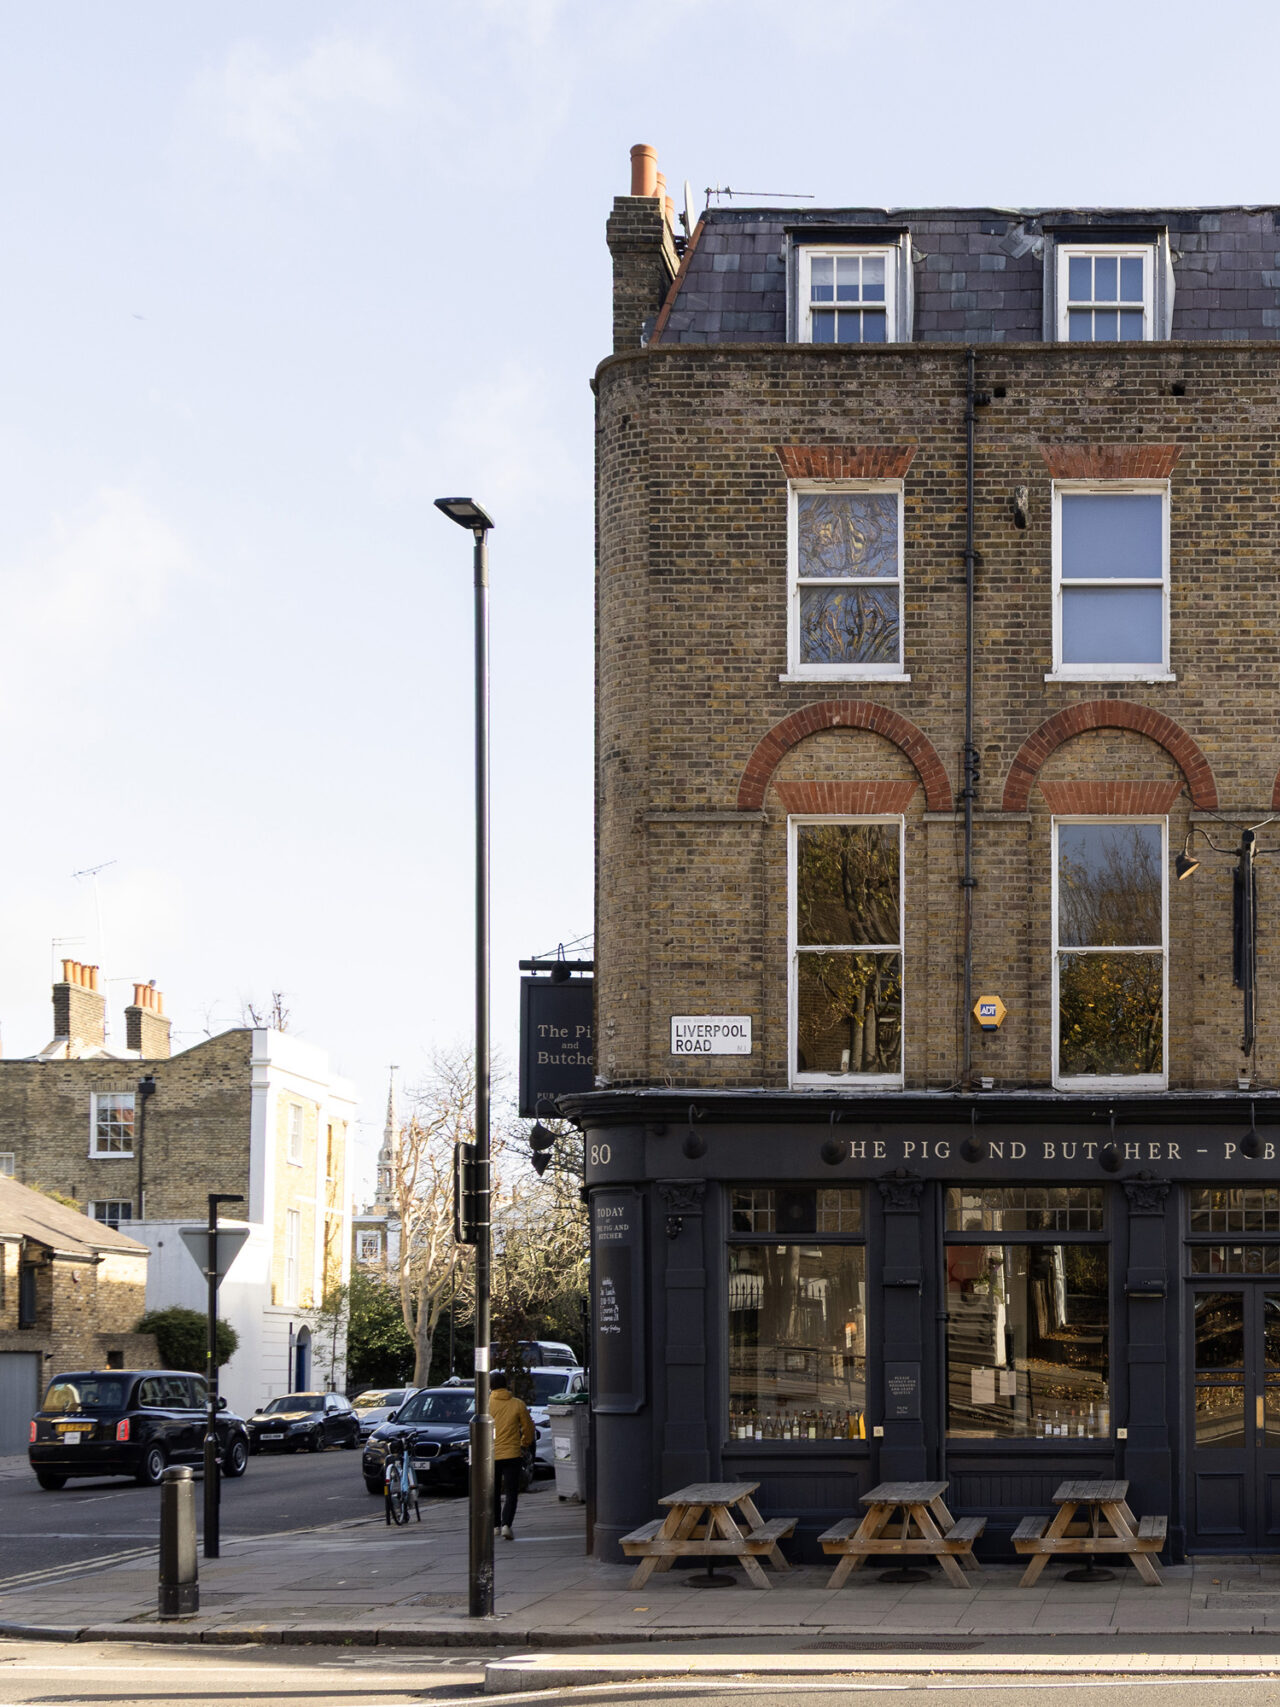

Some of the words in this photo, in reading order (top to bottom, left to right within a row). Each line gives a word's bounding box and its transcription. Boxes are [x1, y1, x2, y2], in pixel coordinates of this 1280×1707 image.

[980, 1006, 996, 1015] ADT
[537, 1024, 568, 1038] The
[575, 1025, 593, 1038] Pi
[676, 1025, 747, 1037] LIVERPOOL
[561, 1041, 580, 1049] and
[676, 1039, 712, 1052] ROAD
[537, 1051, 594, 1065] Butche
[591, 1144, 611, 1165] 80
[843, 1141, 887, 1159] HE
[903, 1141, 951, 1159] PIG
[988, 1141, 1027, 1159] ND
[1224, 1143, 1276, 1160] PB
[597, 1207, 624, 1218] TODAY
